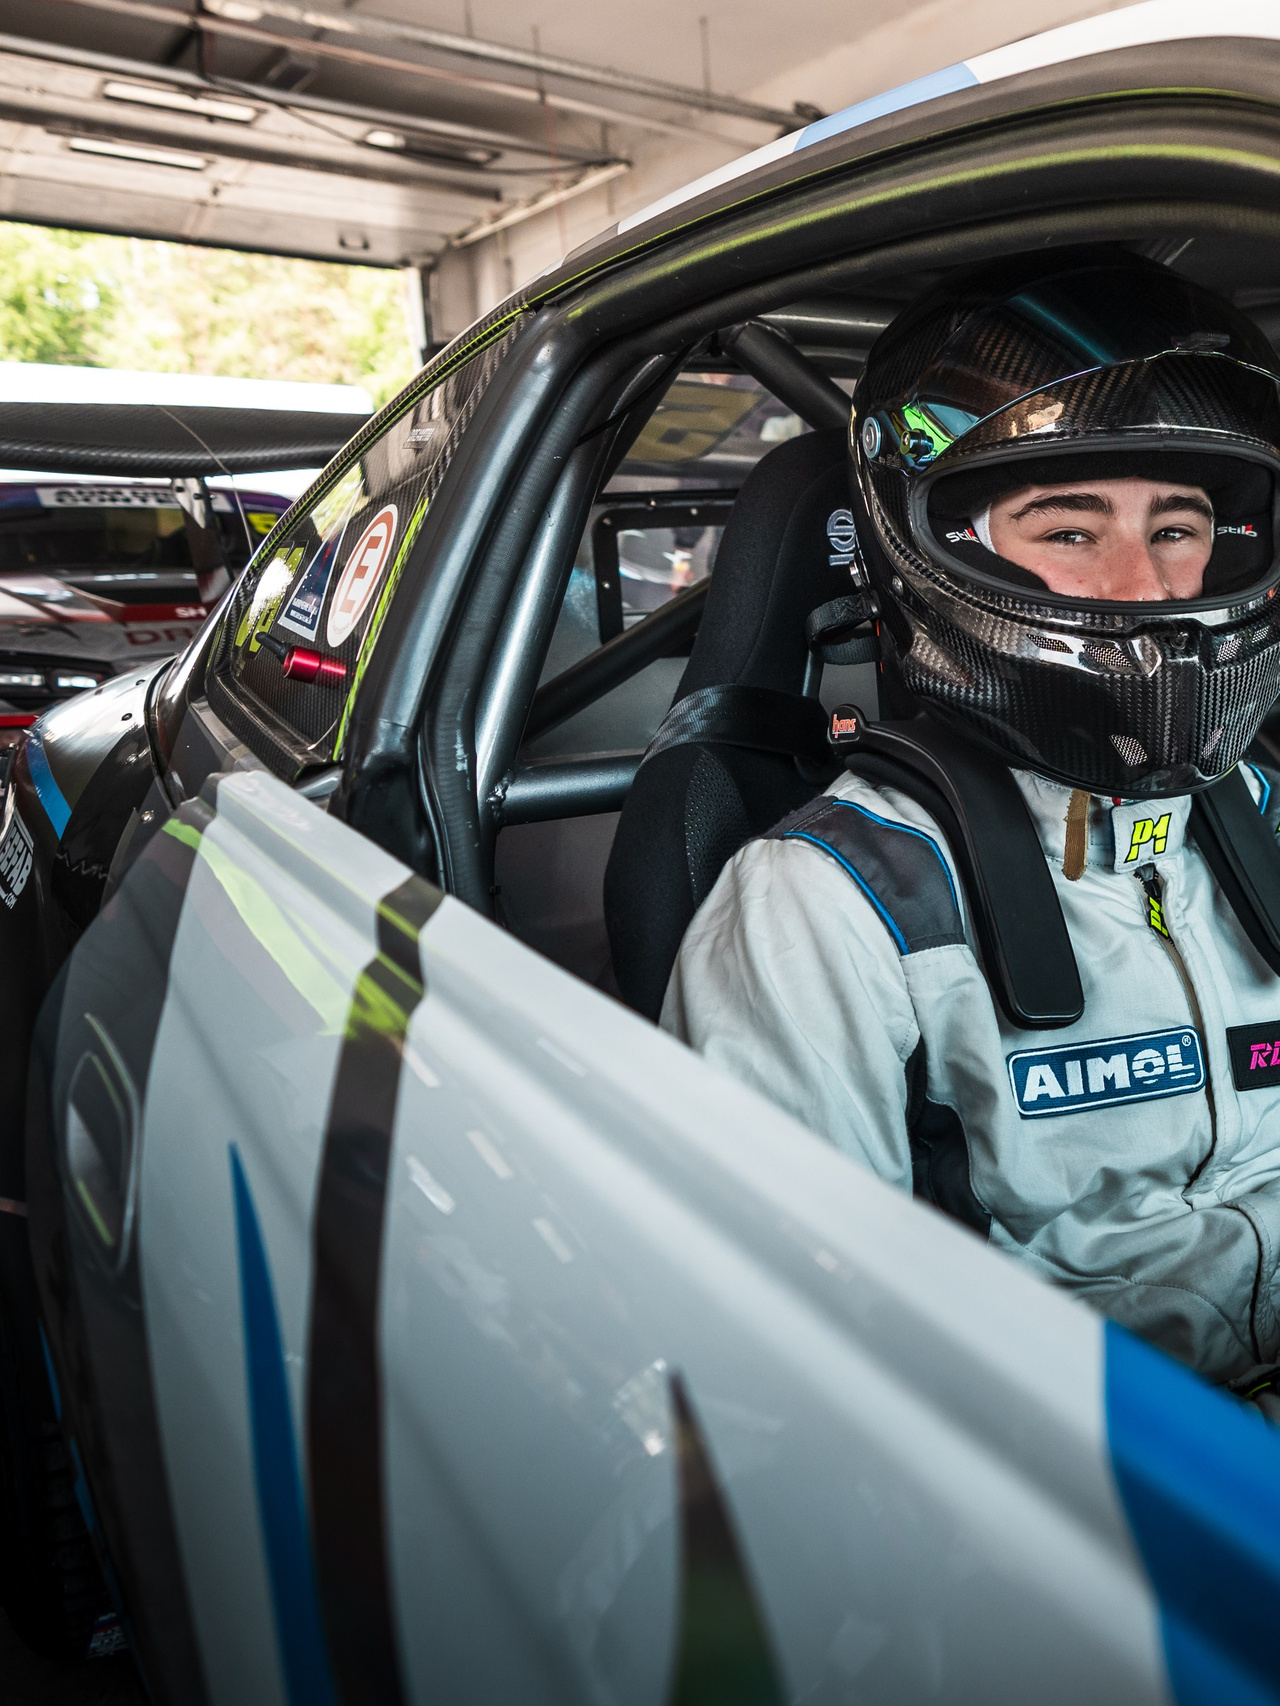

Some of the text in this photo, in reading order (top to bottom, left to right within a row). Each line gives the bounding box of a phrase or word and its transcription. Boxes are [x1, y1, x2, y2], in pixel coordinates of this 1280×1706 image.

[1217, 524, 1258, 538] Stilo
[832, 713, 857, 738] hans
[1124, 812, 1172, 864] P1
[0, 825, 33, 896] SEFAB
